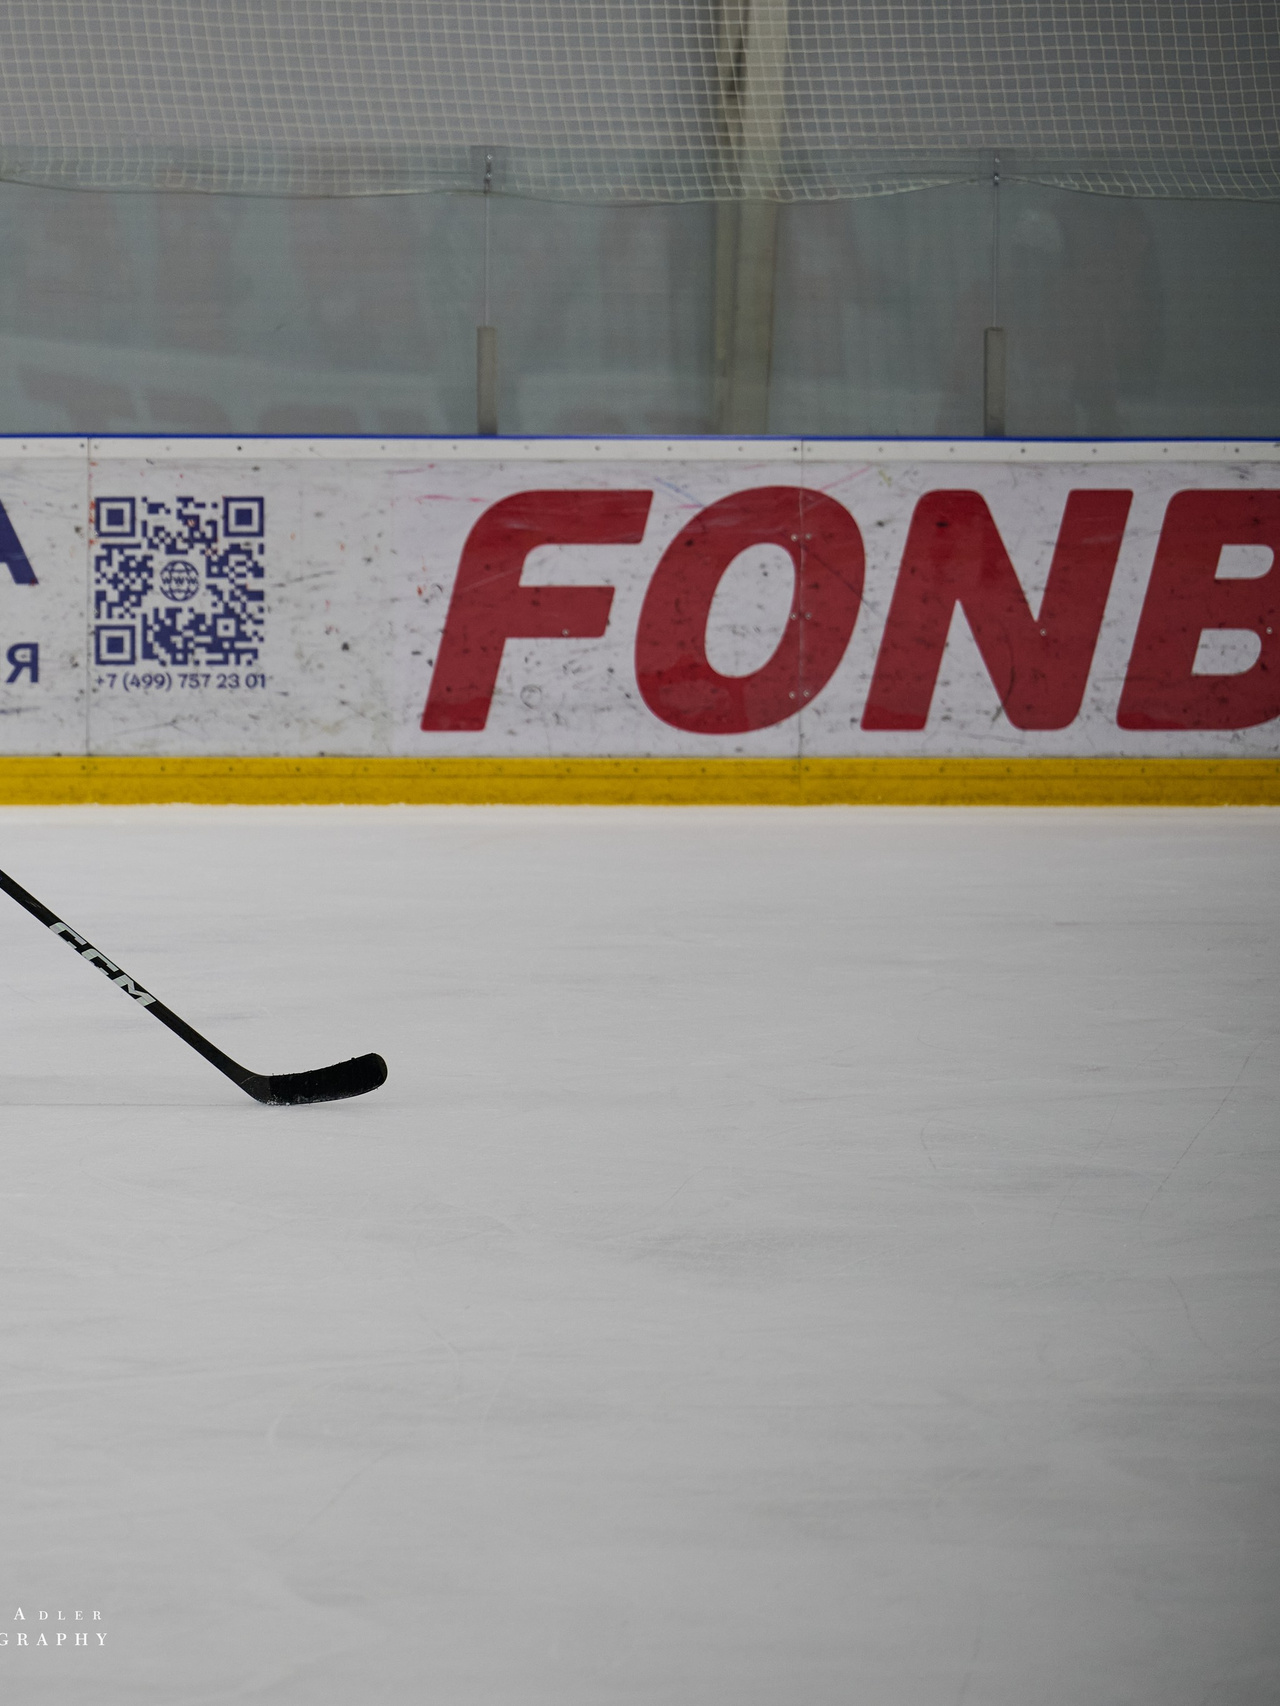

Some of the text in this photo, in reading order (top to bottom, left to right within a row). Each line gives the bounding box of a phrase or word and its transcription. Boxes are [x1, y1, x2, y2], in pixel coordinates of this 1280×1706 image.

[420, 486, 1280, 735] FONB
[95, 672, 267, 692] +7 (499) 757 23 01
[49, 922, 157, 1007] CCM
